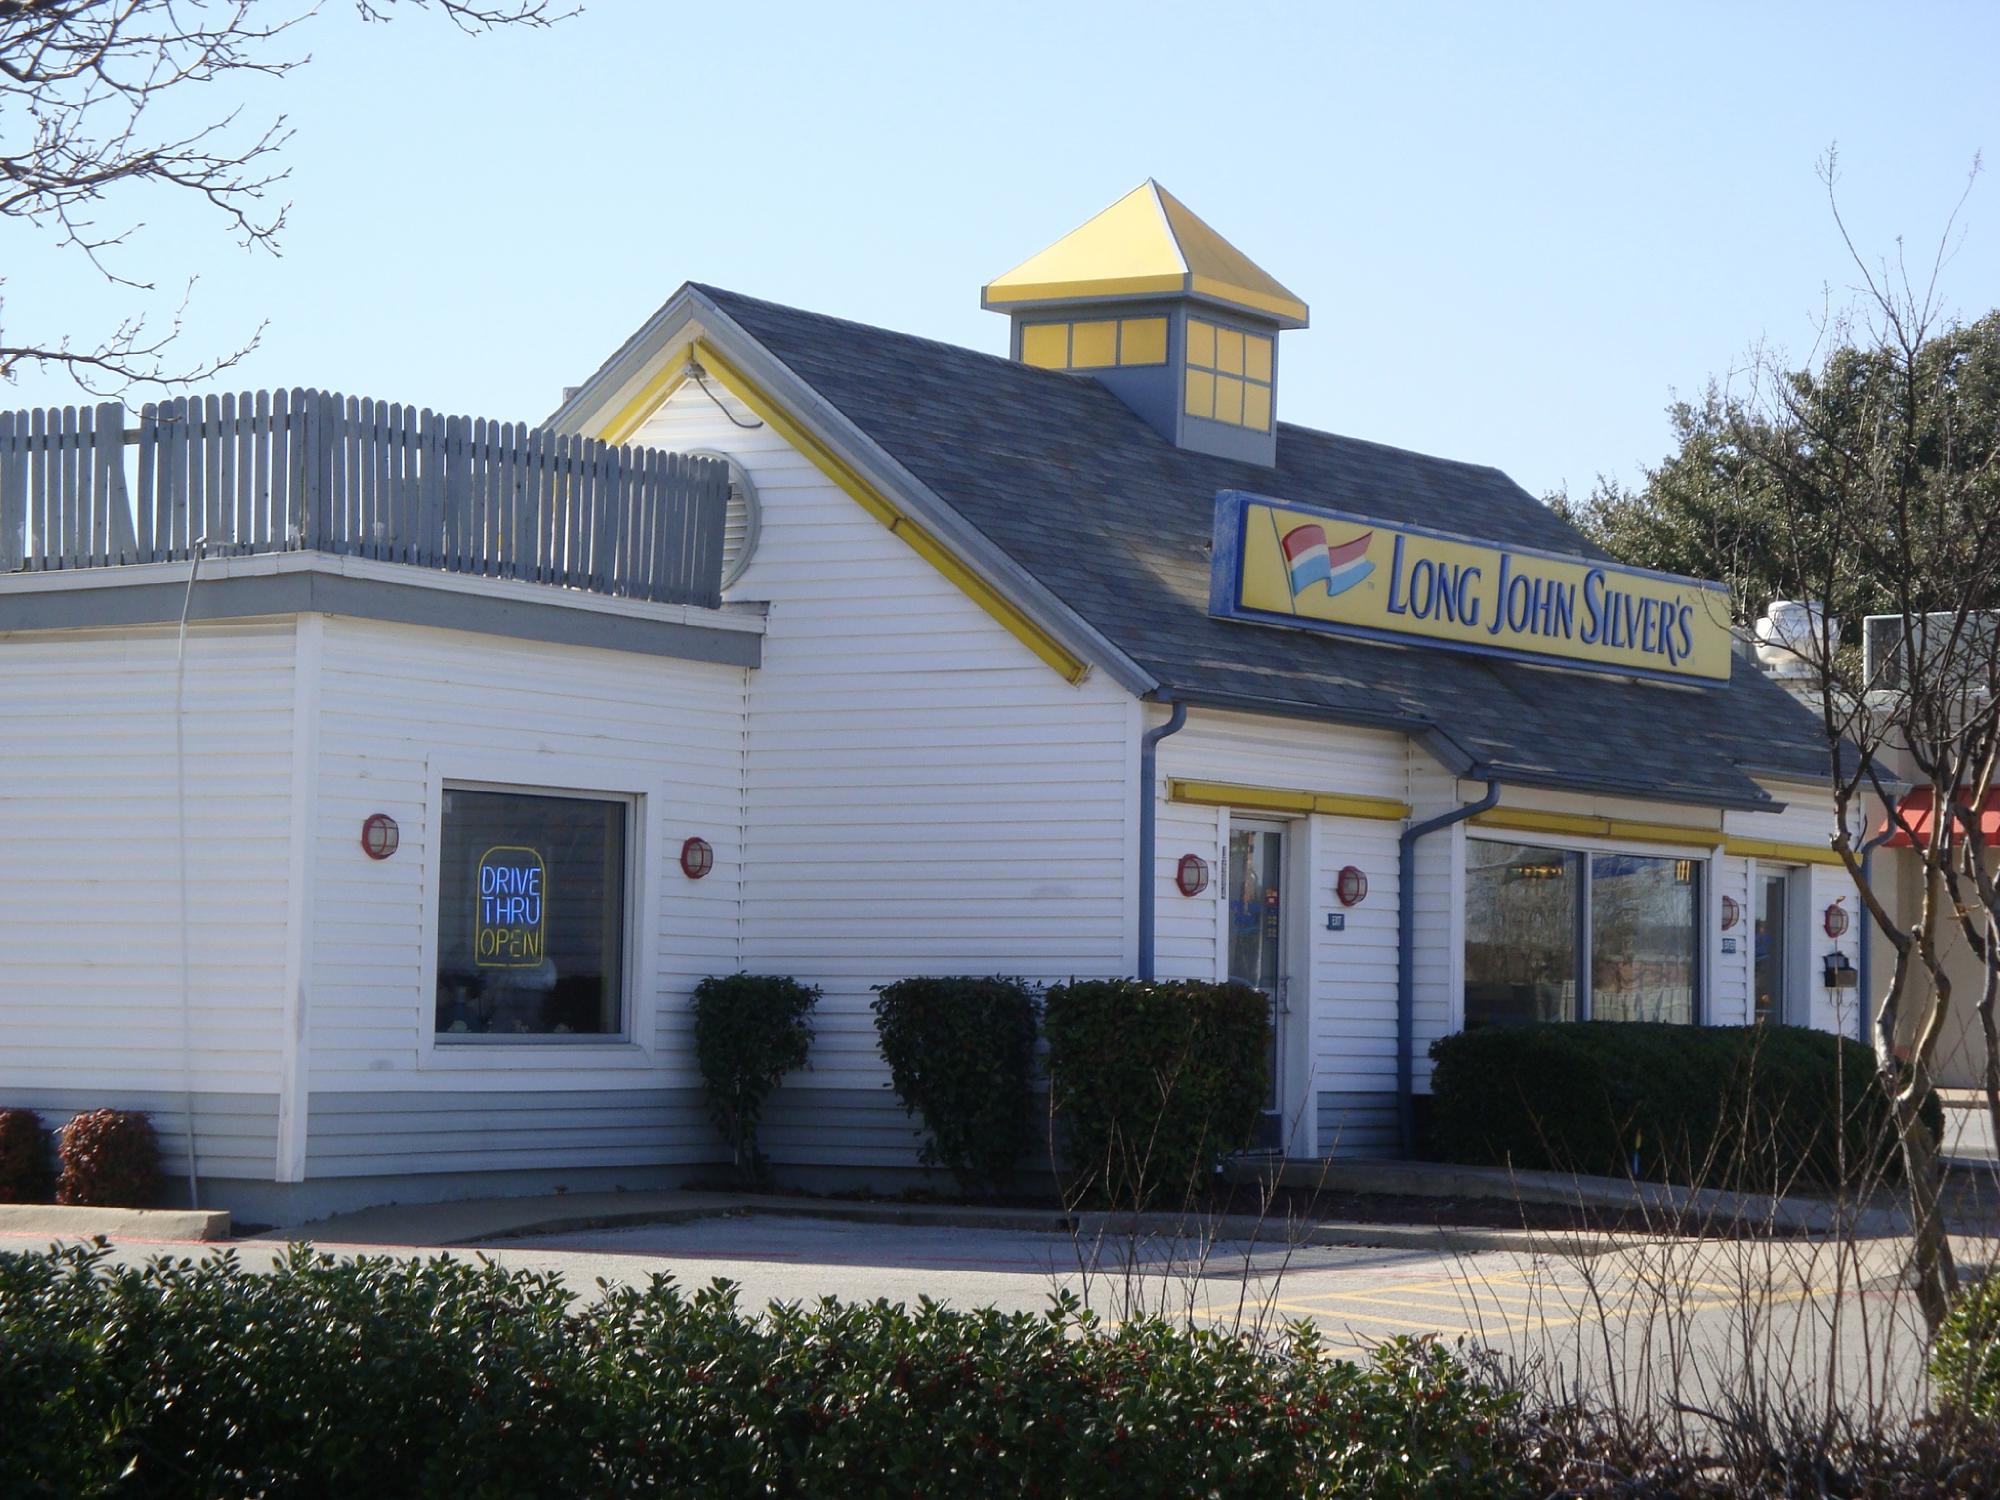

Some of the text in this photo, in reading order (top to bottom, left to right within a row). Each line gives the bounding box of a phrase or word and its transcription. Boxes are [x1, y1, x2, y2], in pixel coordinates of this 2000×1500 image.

[1387, 534, 1693, 667] LONG JOHN SILVER'S
[482, 866, 541, 896] DRIVE
[481, 896, 540, 925] THRU
[480, 928, 539, 957] OPEN
